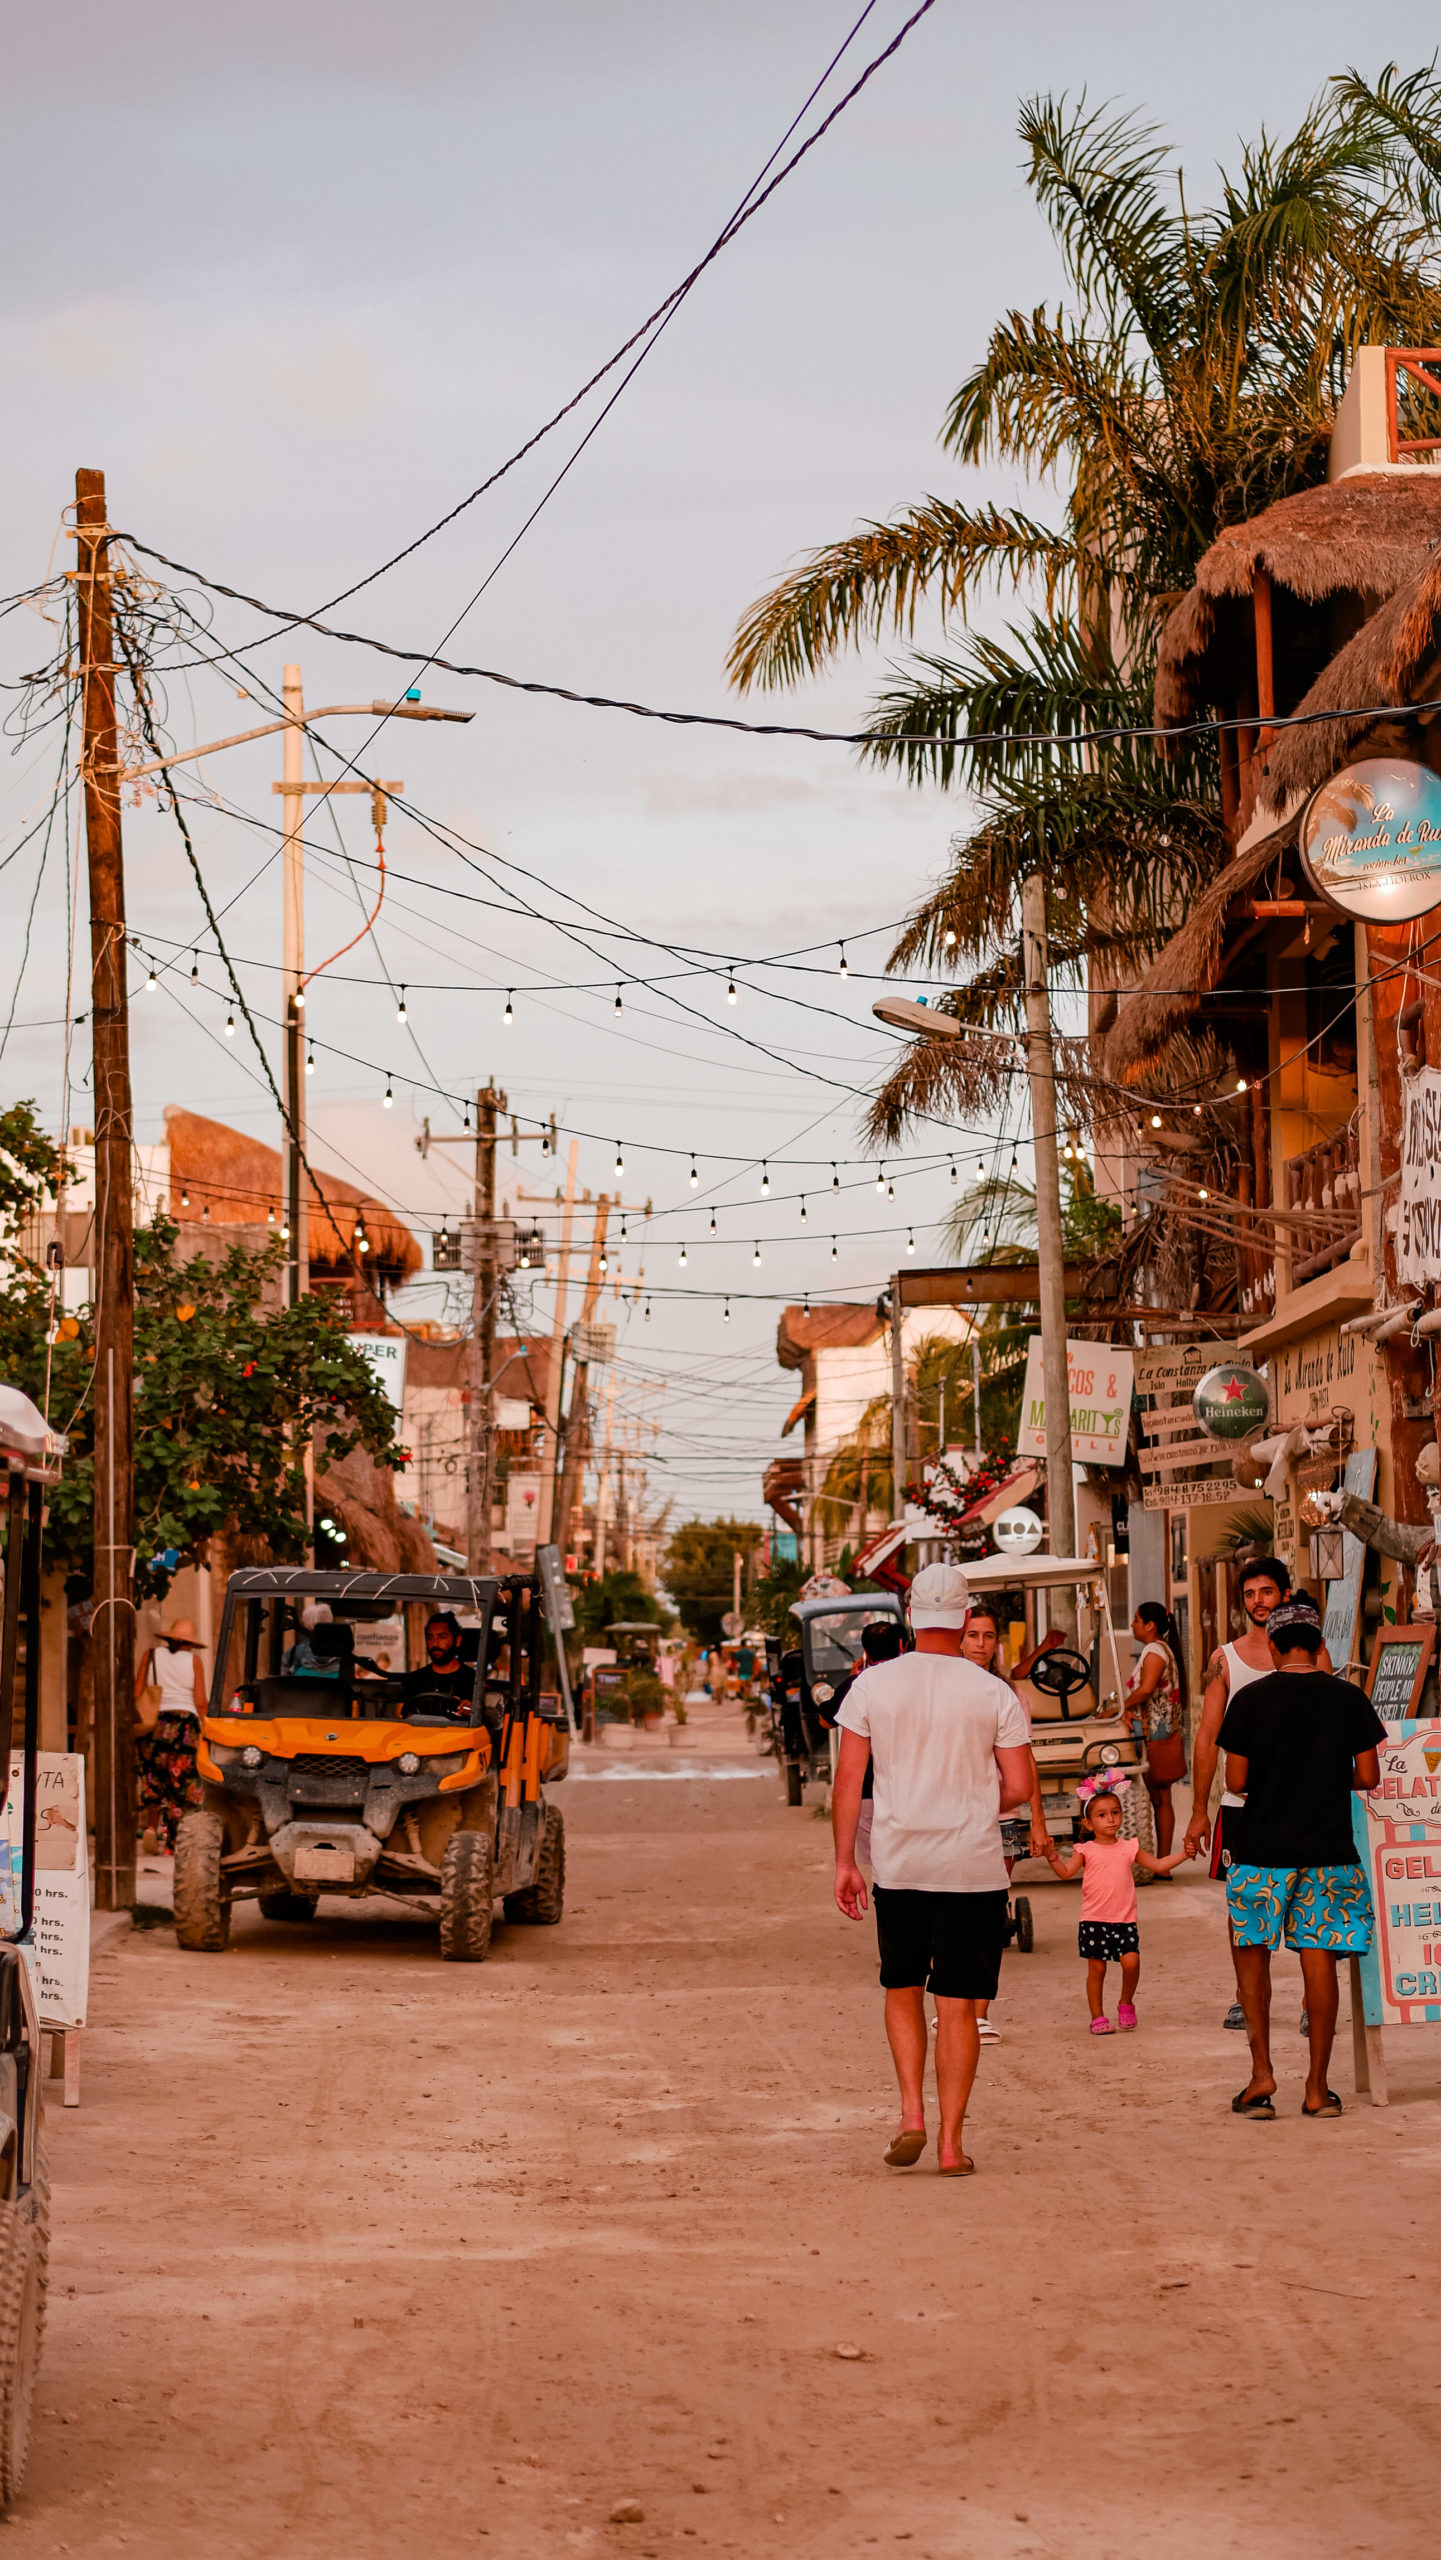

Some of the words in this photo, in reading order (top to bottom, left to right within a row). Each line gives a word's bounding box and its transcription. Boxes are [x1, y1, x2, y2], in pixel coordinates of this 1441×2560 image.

[1371, 803, 1394, 824] La
[1323, 825, 1390, 865] Miranda
[1396, 821, 1414, 844] de
[1327, 1338, 1333, 1383] de
[1138, 1367, 1153, 1380] La
[1156, 1362, 1207, 1378] Constanza
[1107, 1374, 1117, 1398] &
[1176, 1378, 1201, 1388] Holbo
[1205, 1407, 1263, 1418] Heineken
[1036, 1435, 1115, 1452] GILL
[1157, 1482, 1178, 1496] 984
[1381, 1655, 1415, 1676] SKINNY
[1375, 1680, 1402, 1701] PEOPLE
[1385, 1755, 1408, 1773] La
[1369, 1776, 1441, 1800] GELAT
[1386, 1856, 1441, 1879] GEL
[45, 1889, 68, 1899] hrs.
[41, 1917, 64, 1927] hrs.
[1391, 1903, 1441, 1927] HEL
[41, 1932, 63, 1941] hrs.
[40, 1946, 63, 1956] hrs.
[42, 1976, 64, 1986] hrs.
[1396, 1971, 1441, 1996] CR
[41, 1990, 63, 2000] hrs.
